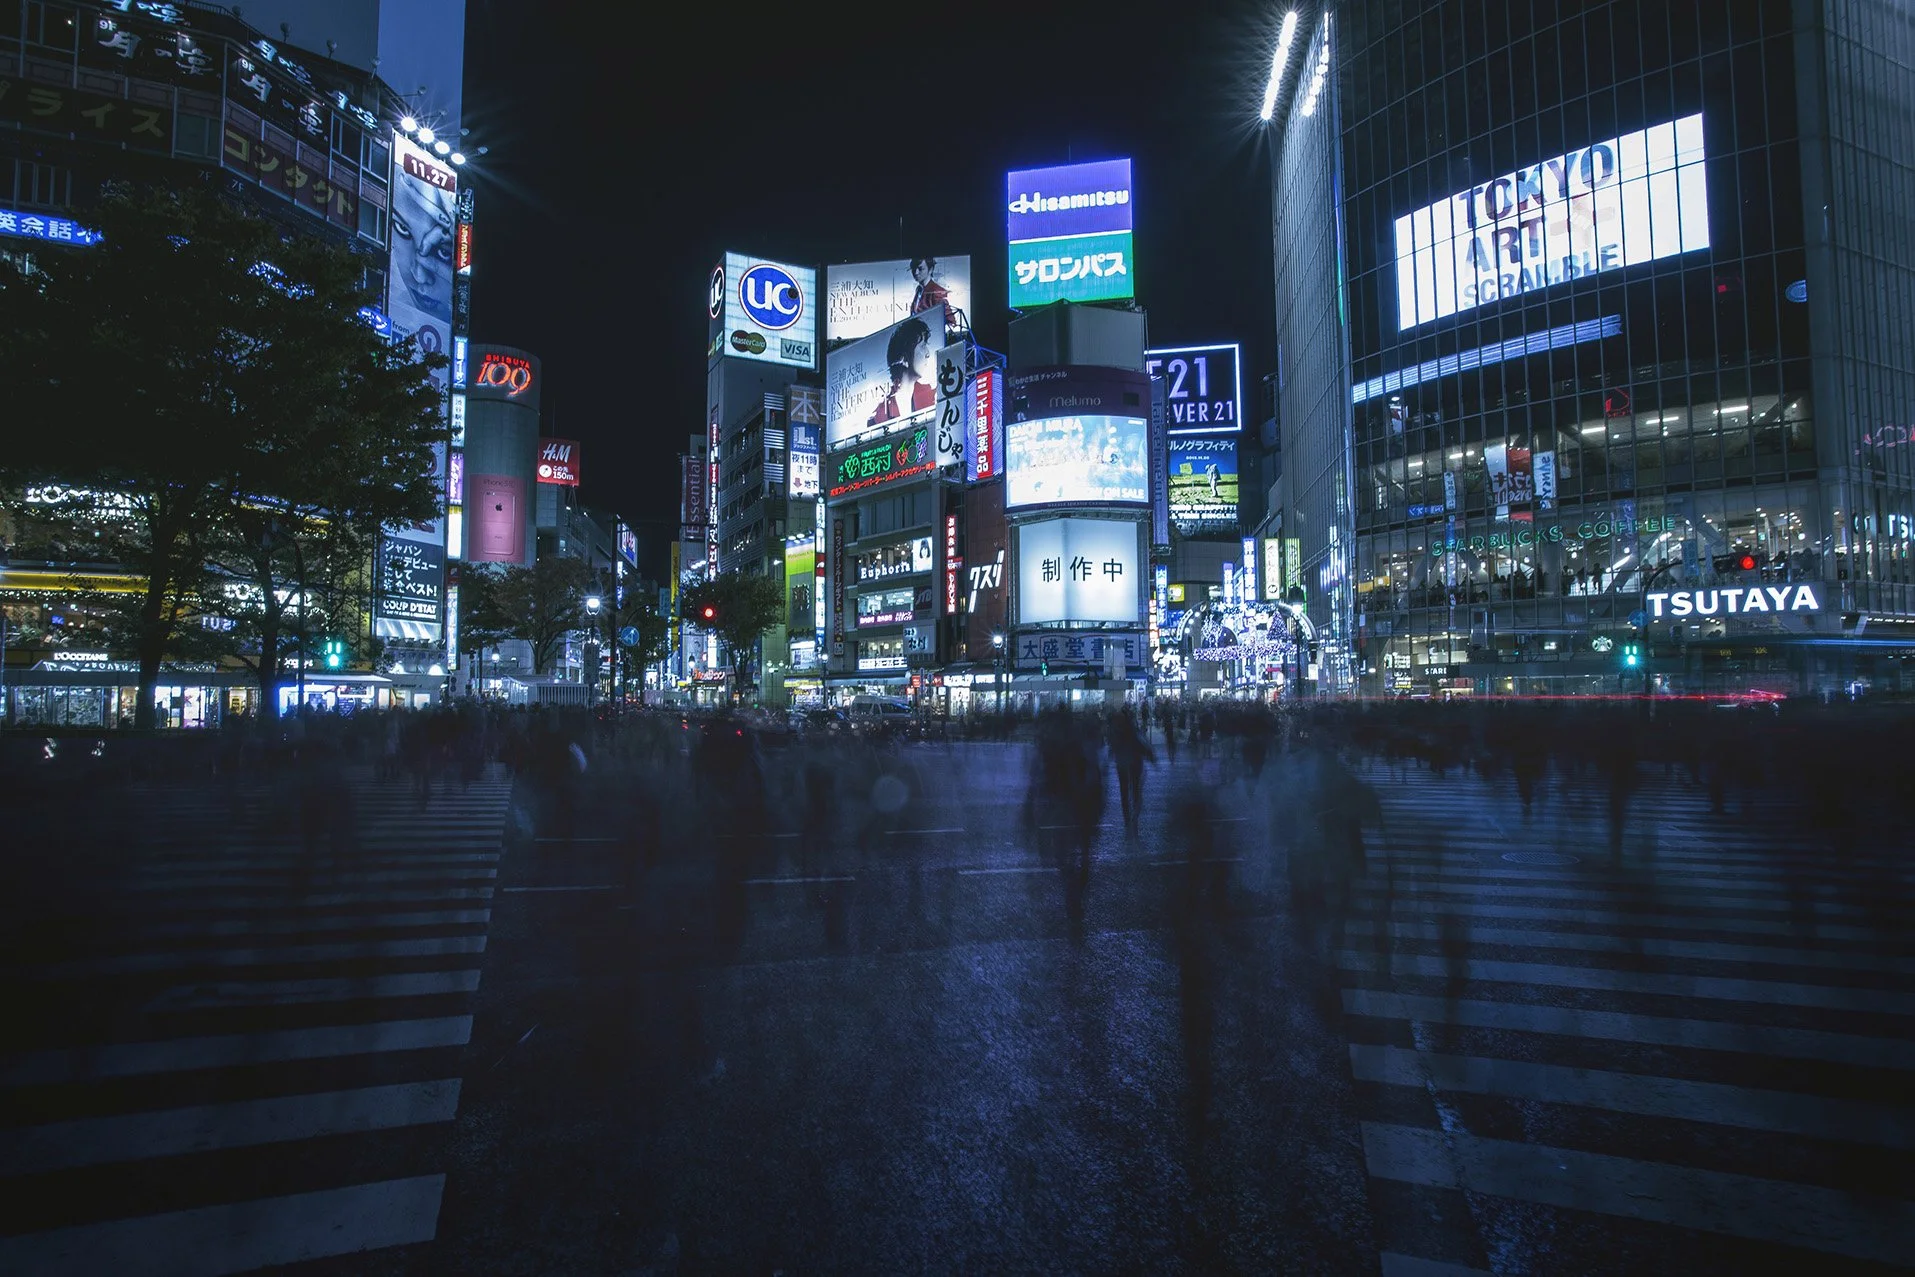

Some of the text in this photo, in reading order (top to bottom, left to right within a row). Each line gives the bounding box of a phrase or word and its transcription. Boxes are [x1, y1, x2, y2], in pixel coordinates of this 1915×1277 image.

[99, 20, 117, 31] 9F
[225, 130, 354, 214] コンタクト
[411, 160, 449, 187] 11.27
[1459, 144, 1615, 229] TOKYO
[1009, 190, 1129, 213] Hisamitsu
[1463, 216, 1546, 277] ART
[1015, 252, 1126, 285] サロンパス
[1463, 243, 1618, 307] SCRAMBLE
[830, 280, 873, 292] 三浦大知
[850, 289, 878, 298] ALBUM
[392, 320, 410, 334] from
[732, 336, 766, 348] MasterCard
[784, 344, 810, 357] VISA
[485, 354, 530, 369] SHIBUYA
[475, 361, 532, 397] 109
[791, 391, 820, 423] 本
[939, 358, 963, 459] もんじゃ
[1050, 395, 1101, 407] melumo
[1215, 400, 1234, 421] 21
[977, 377, 990, 473] 三千里薬品
[543, 443, 571, 463] H&M
[1169, 440, 1235, 451] ルノグラフィティ
[553, 472, 574, 480] 150m
[861, 452, 891, 477] 西村
[687, 459, 700, 534] Essential
[1432, 514, 1676, 557] STARBUCKS COFFEE
[860, 561, 911, 580] Euphoria
[1042, 556, 1123, 582] 制作中
[383, 600, 408, 611] COUP
[1647, 585, 1819, 617] TSUTAYA
